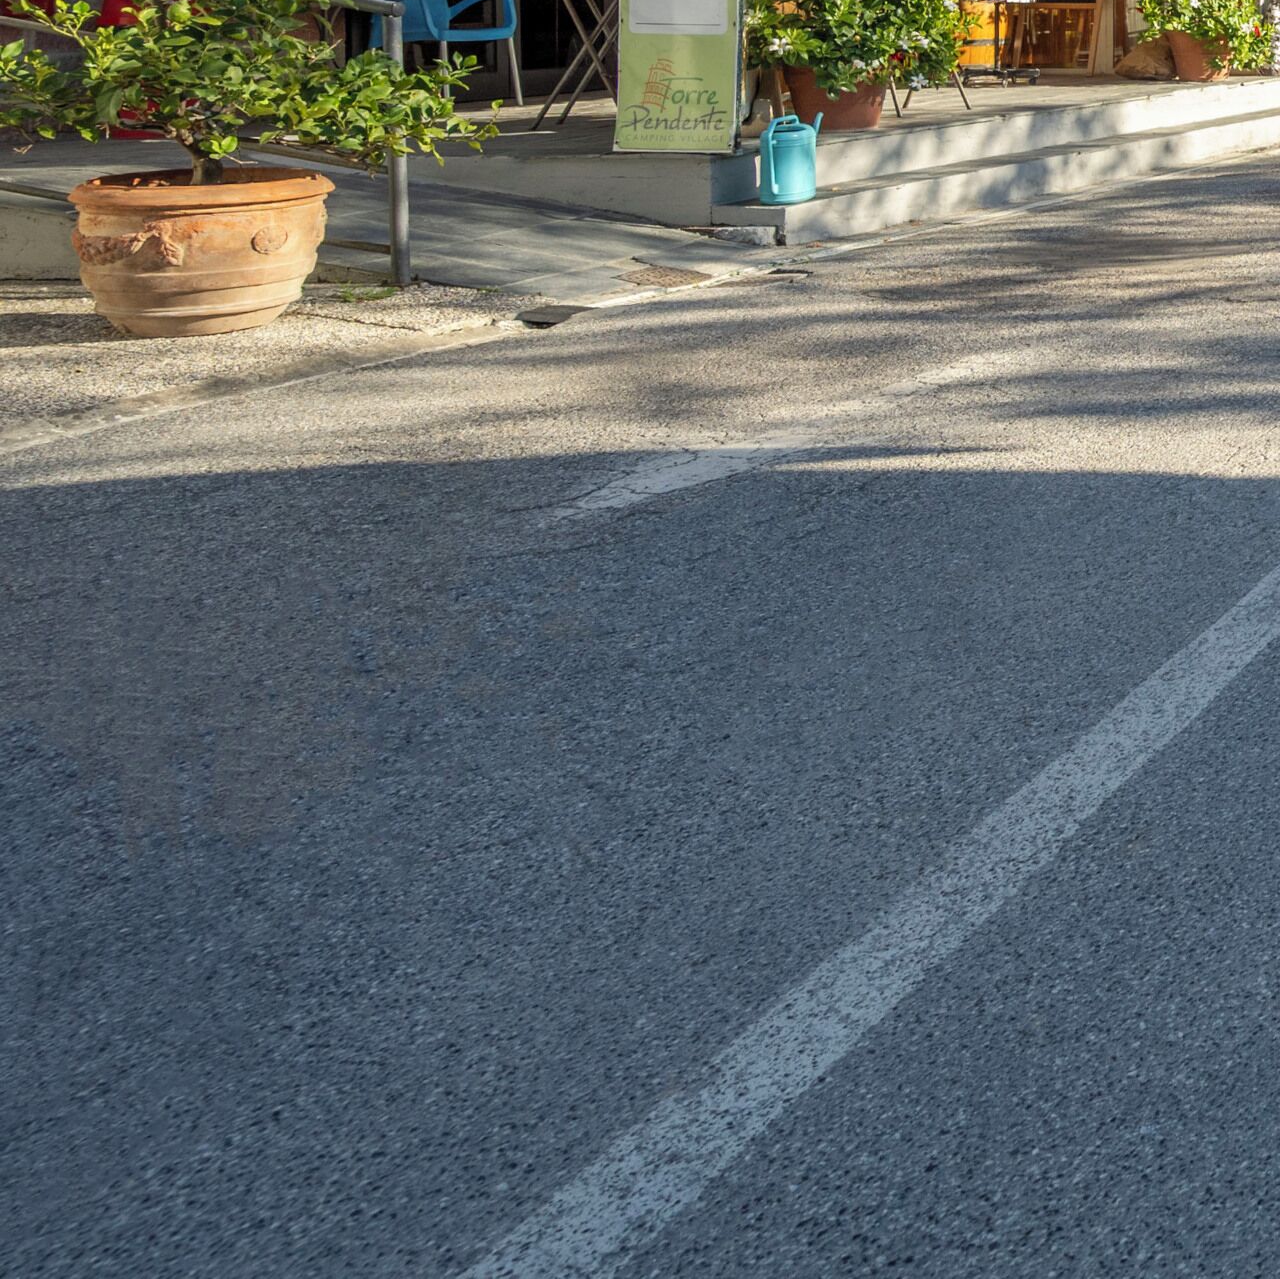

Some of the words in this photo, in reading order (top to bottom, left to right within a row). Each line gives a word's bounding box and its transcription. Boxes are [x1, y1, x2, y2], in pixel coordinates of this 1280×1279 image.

[660, 76, 719, 112] Torre
[621, 105, 728, 132] Pendente
[625, 134, 675, 143] CAMPING
[680, 135, 724, 144] VILLAGE
